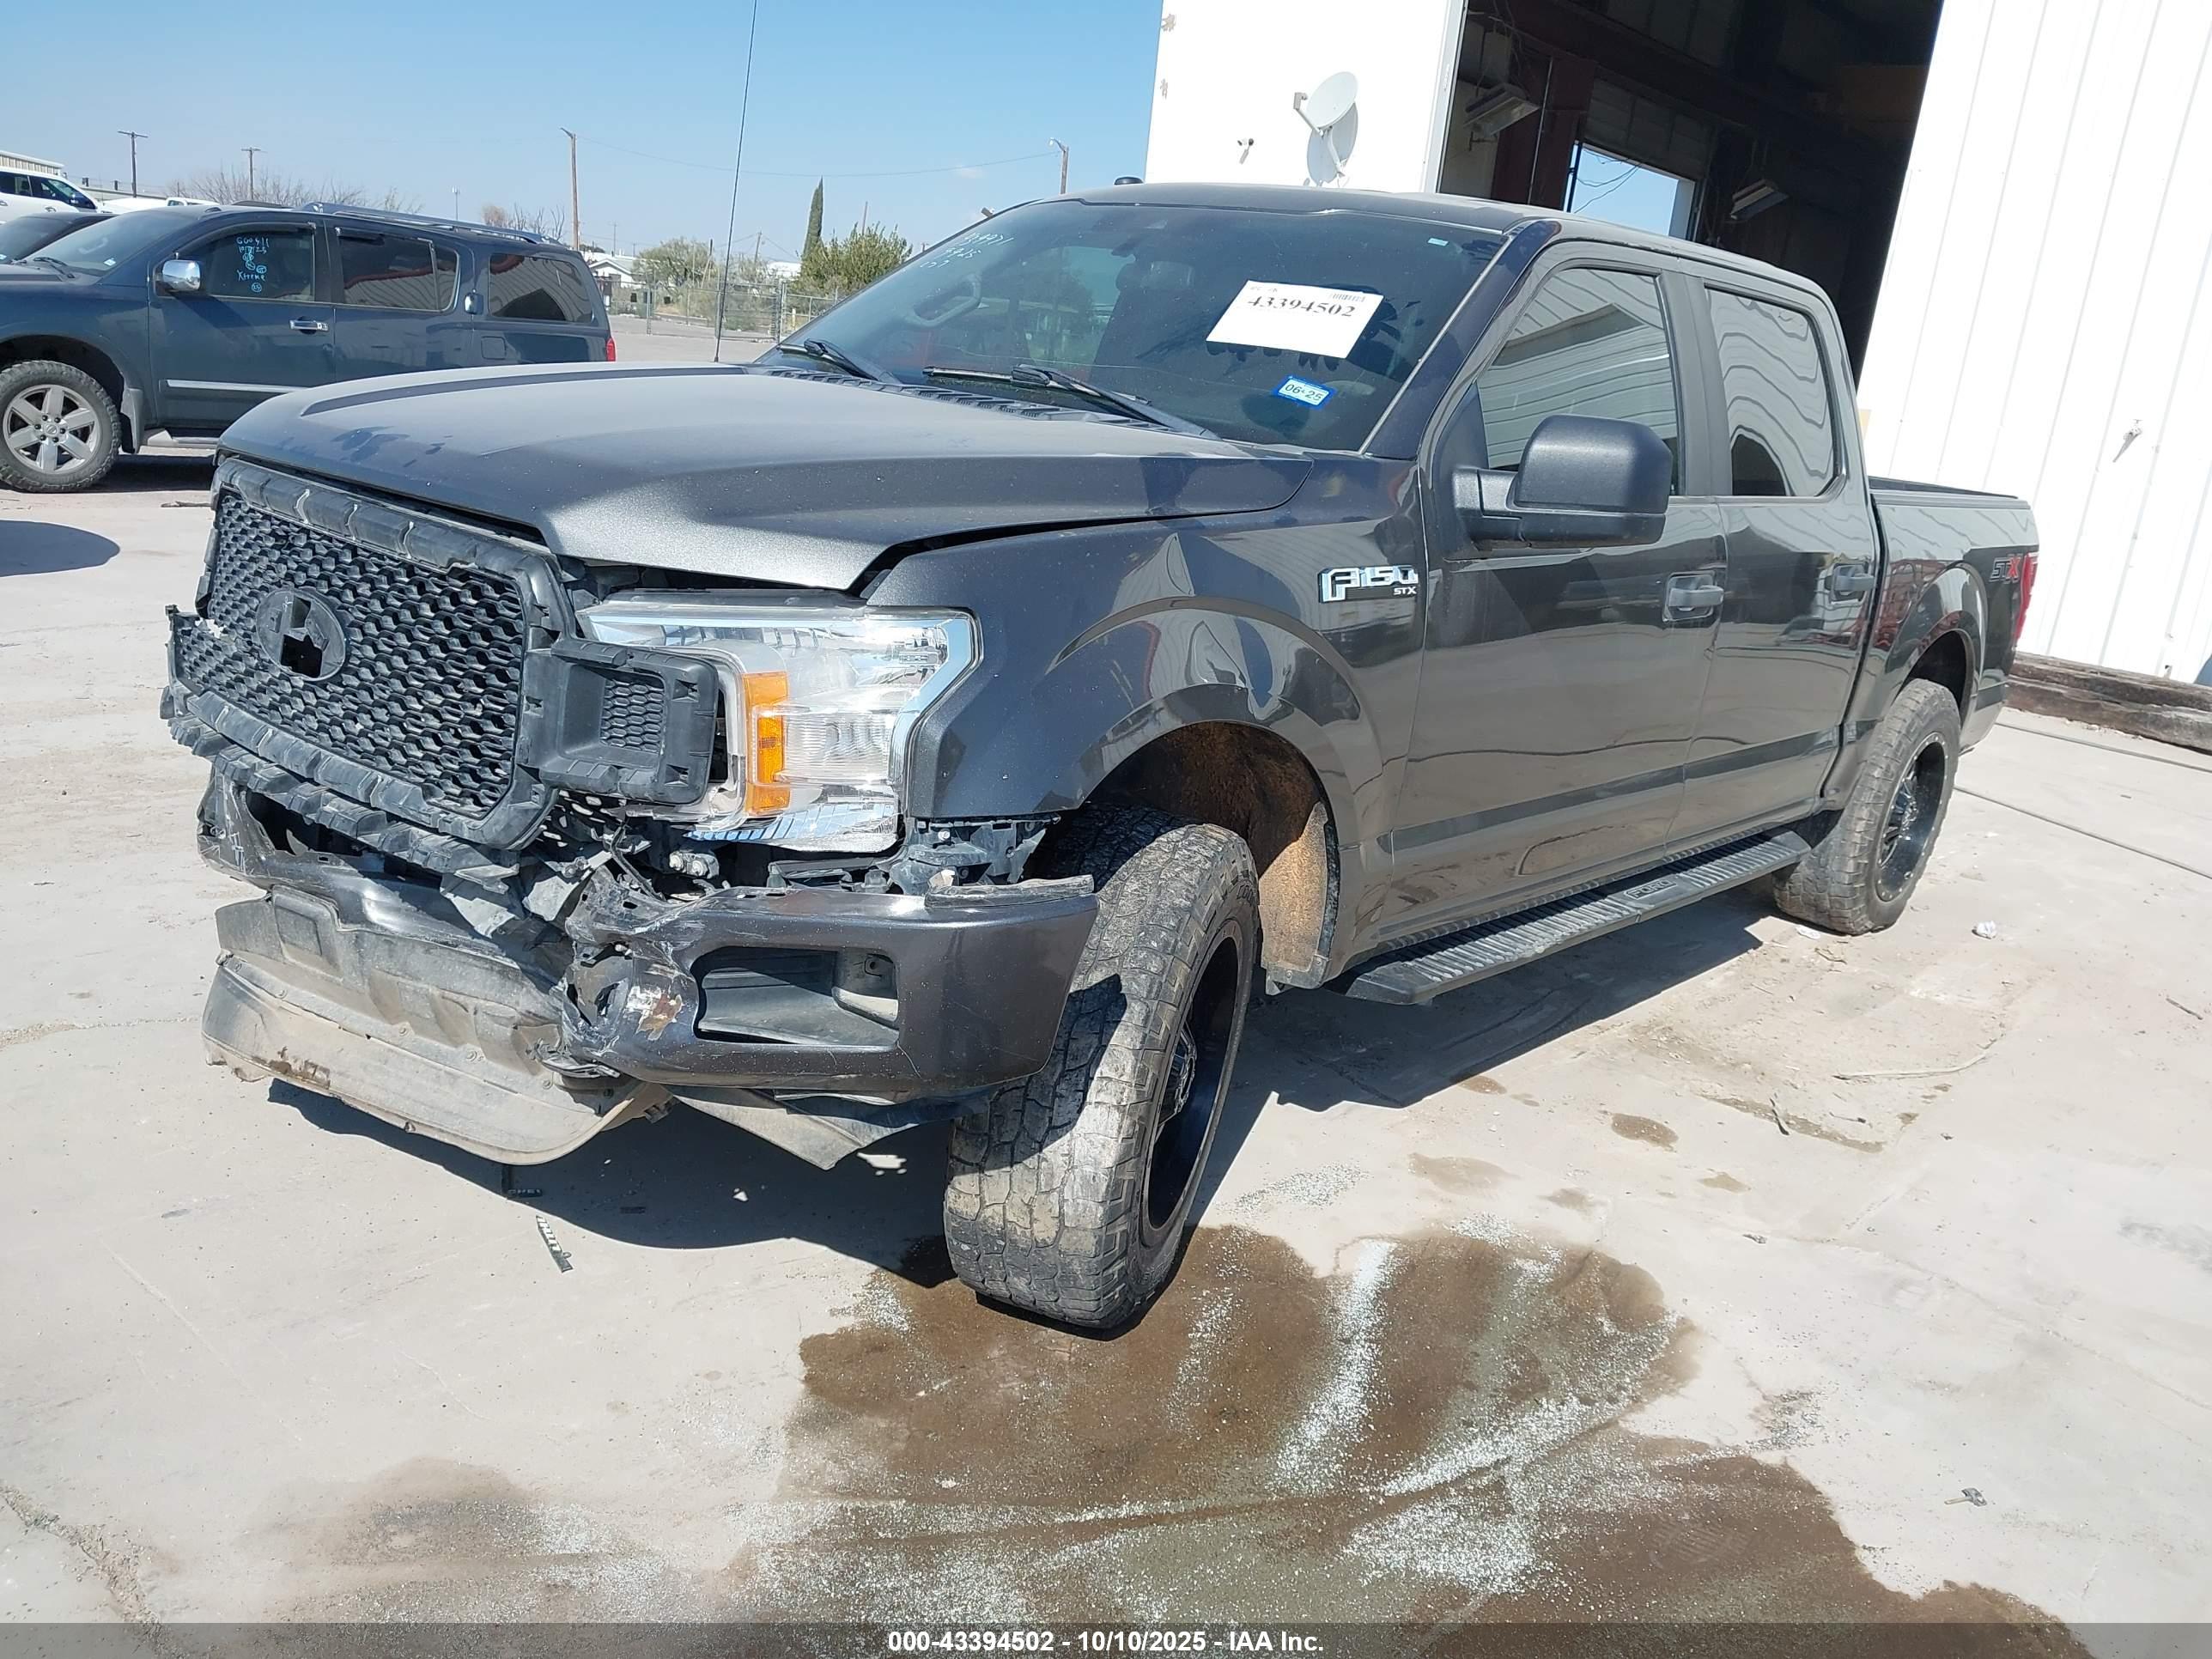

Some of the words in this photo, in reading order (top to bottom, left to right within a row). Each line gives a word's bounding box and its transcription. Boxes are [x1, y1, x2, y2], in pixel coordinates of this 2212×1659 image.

[1248, 295, 1356, 317] 43394502
[1285, 384, 1303, 394] 06
[1304, 390, 1324, 401] 25
[1990, 556, 2021, 583] STX
[1394, 586, 1417, 596] STX
